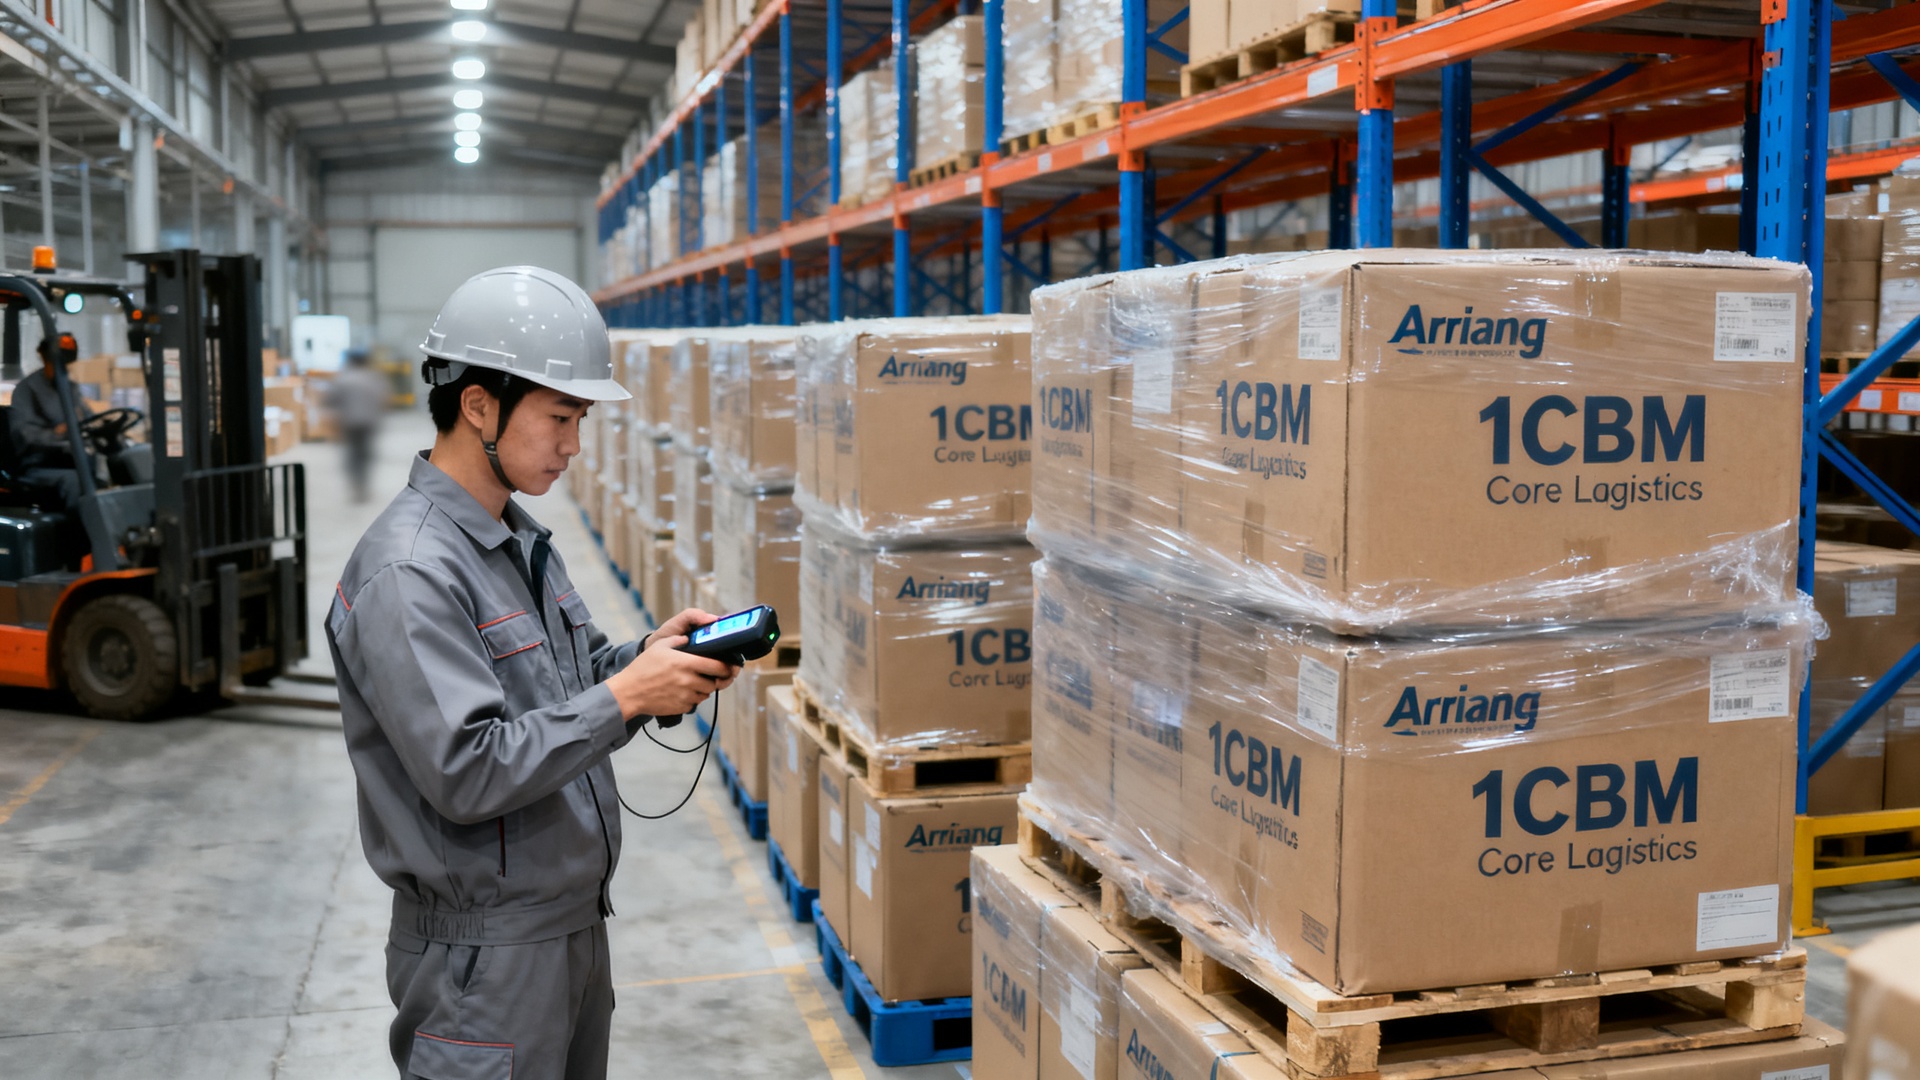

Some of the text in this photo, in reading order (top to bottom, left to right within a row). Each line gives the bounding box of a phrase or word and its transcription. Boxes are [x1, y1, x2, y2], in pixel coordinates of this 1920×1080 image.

[1387, 304, 1548, 359] Arriang
[1216, 379, 1312, 445] 1CBM
[1479, 394, 1706, 467] 1CBM
[1486, 475, 1562, 505] Core
[1383, 684, 1542, 732] Arriang
[1208, 720, 1302, 817] 1CBM
[1472, 756, 1698, 838] 1CBM
[1478, 847, 1555, 877] Core
